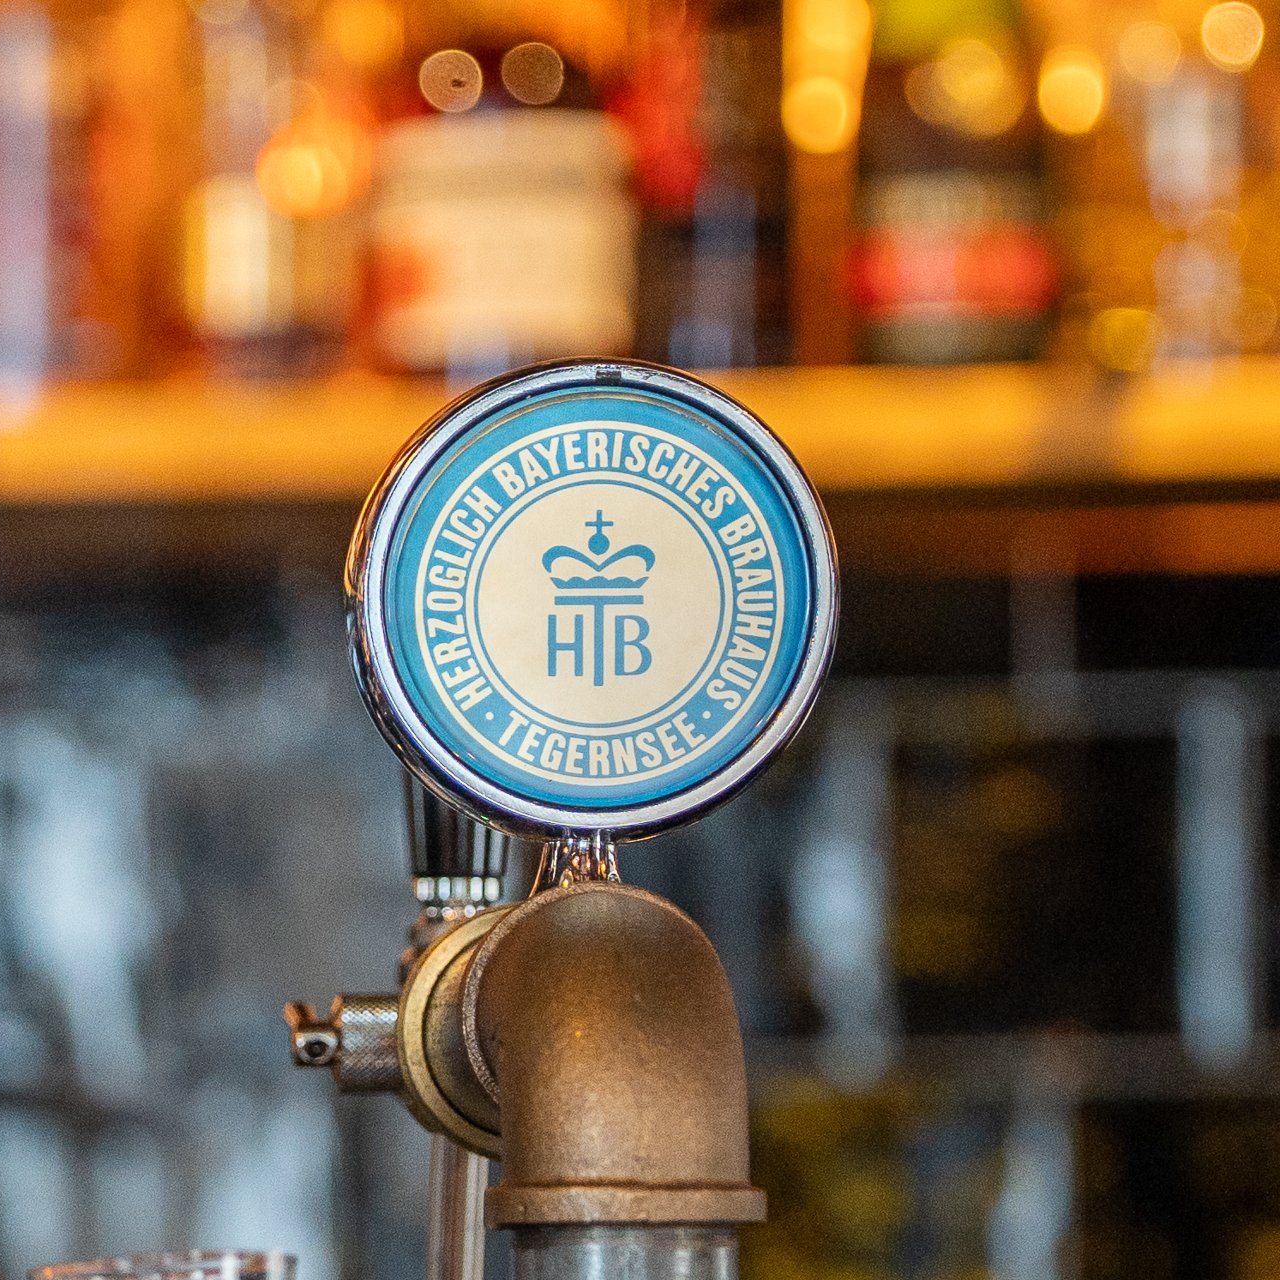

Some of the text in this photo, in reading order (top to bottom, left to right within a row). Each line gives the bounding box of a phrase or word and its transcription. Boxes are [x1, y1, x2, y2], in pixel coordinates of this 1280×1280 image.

[427, 431, 776, 712] HERZOGLICH BAYERISCHES BRAUHAUS
[496, 711, 706, 777] TEGERNSEE
